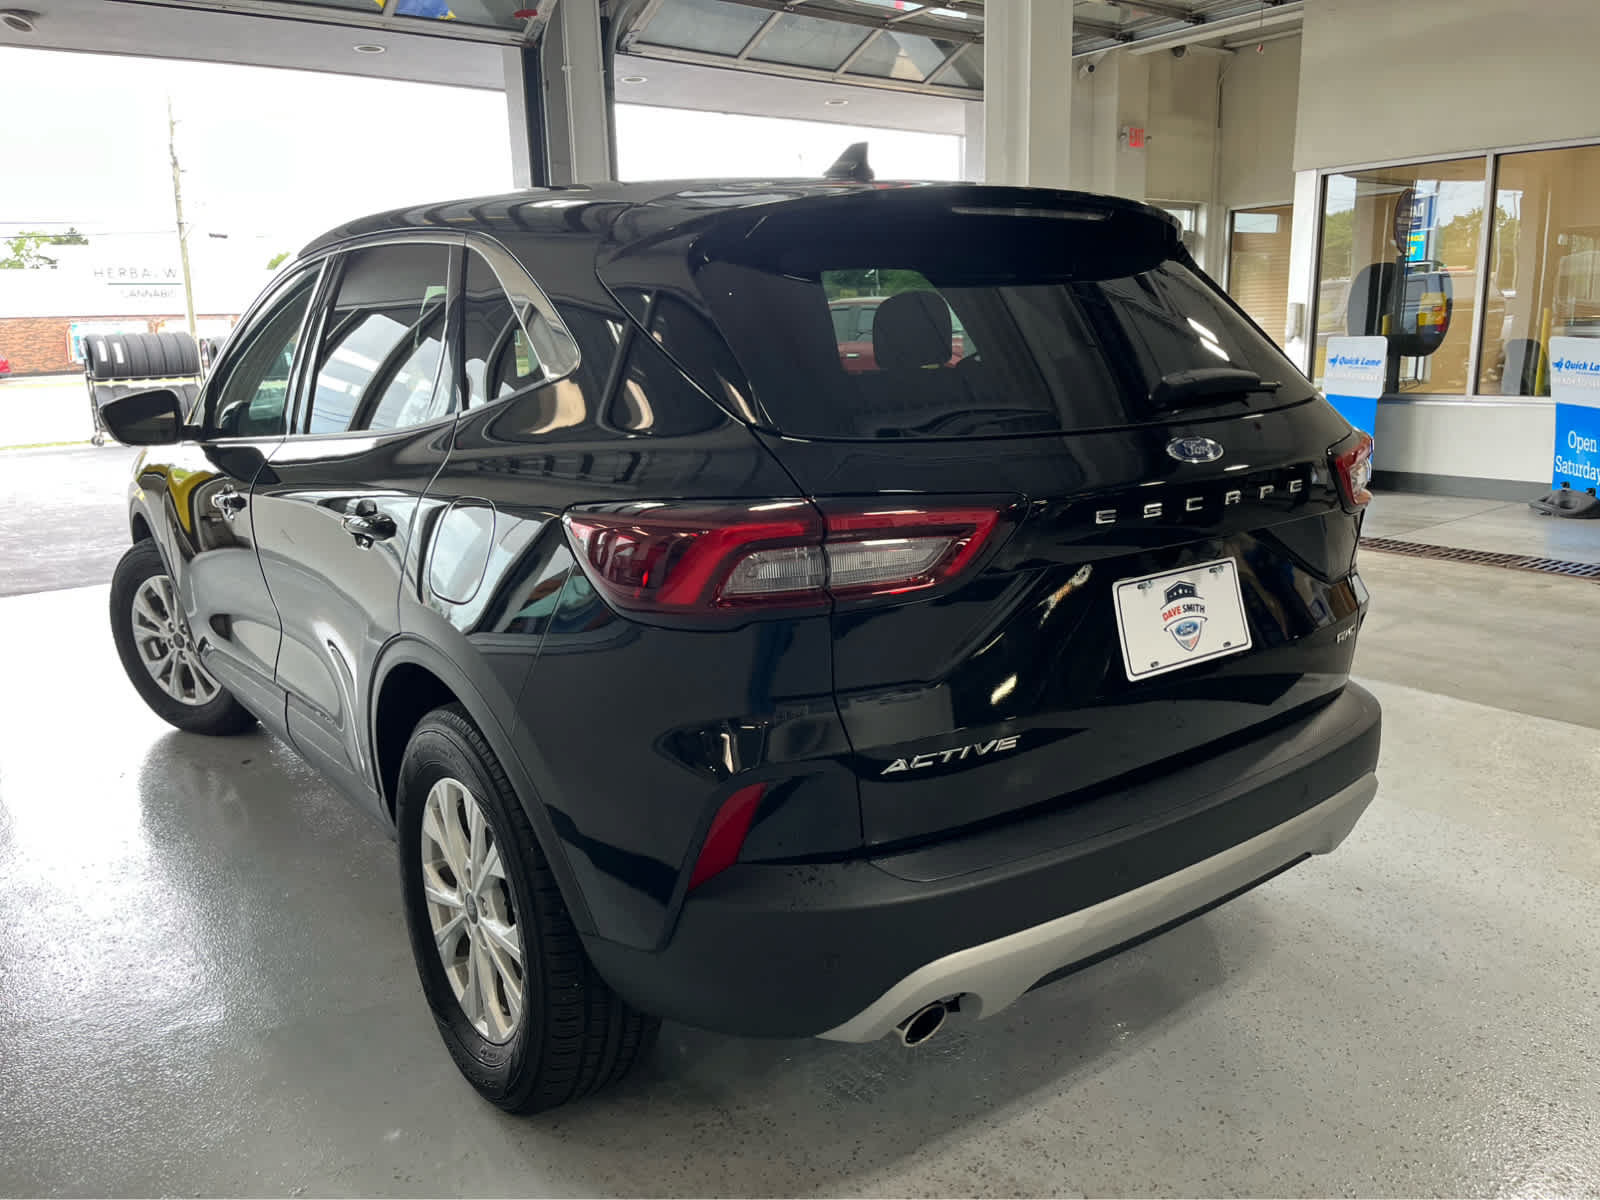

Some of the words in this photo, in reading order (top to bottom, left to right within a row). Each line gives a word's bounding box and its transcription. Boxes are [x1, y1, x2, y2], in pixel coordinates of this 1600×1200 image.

[1564, 360, 1588, 371] Quick
[1567, 430, 1597, 454] Open
[1095, 479, 1303, 525] ESCAPE
[1162, 605, 1182, 622] DAVE
[1182, 604, 1205, 614] SMITH
[880, 734, 1022, 775] ACTIVE
